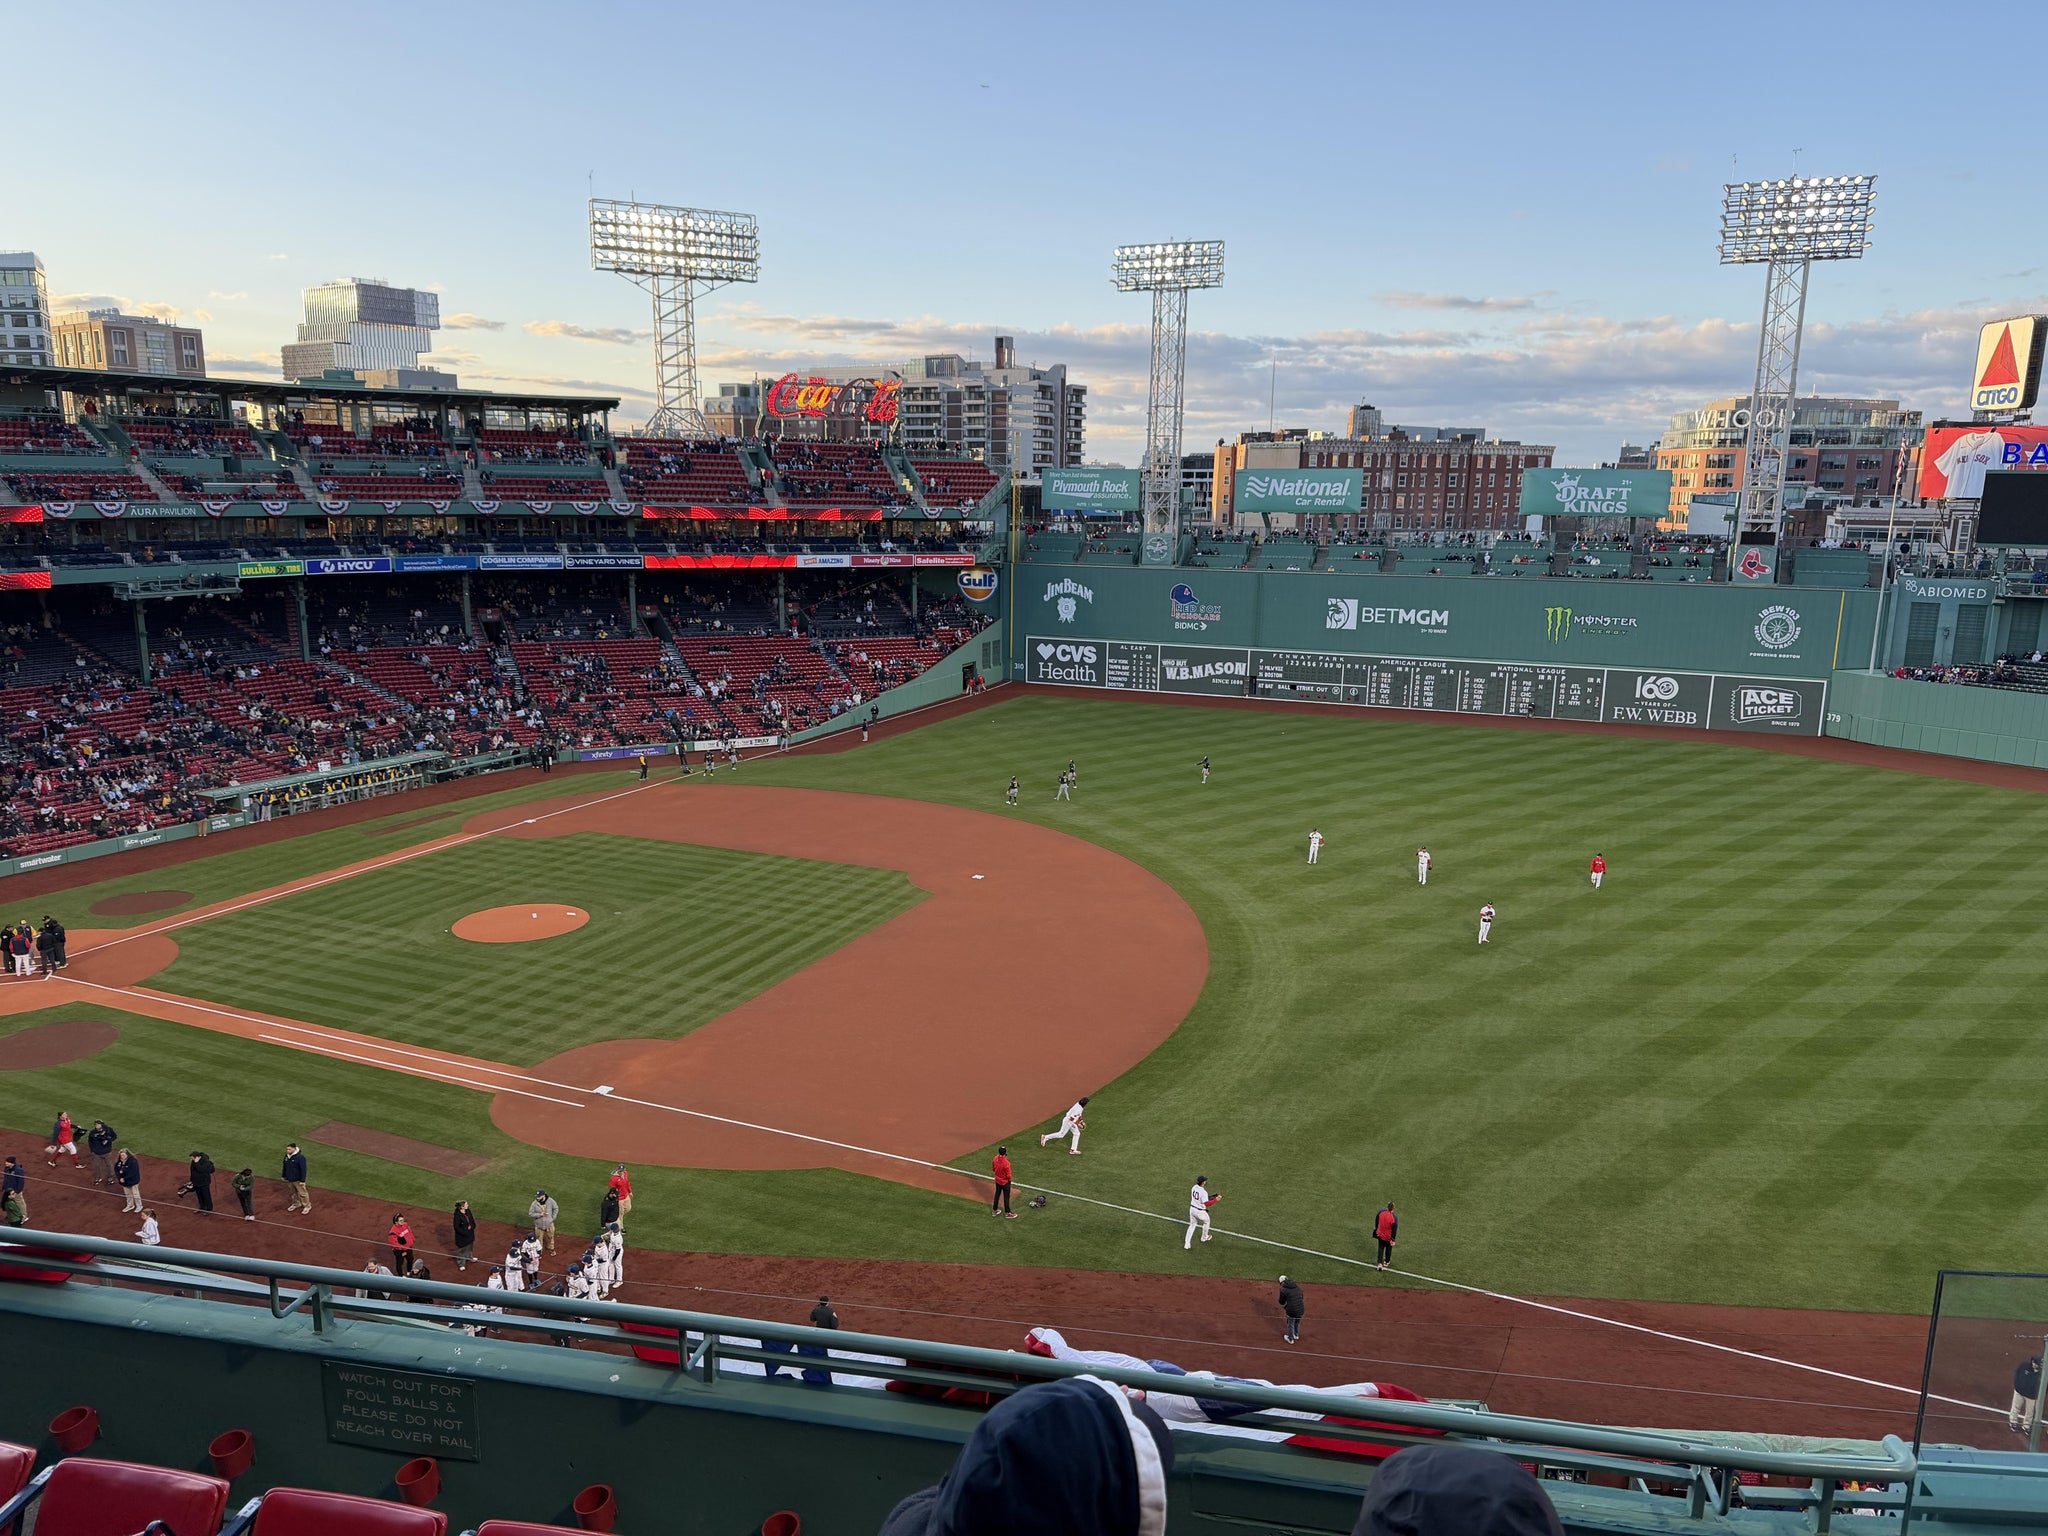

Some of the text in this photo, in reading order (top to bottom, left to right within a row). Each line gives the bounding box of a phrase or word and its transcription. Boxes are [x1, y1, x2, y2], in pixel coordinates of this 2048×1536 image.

[1977, 387, 2018, 406] CITGO
[1974, 454, 1990, 465] SOX
[1052, 480, 1129, 493] Plymouth Rock
[1556, 485, 1632, 502] DRAFT
[160, 508, 196, 516] PAVILION
[1564, 500, 1627, 513] KINGS
[241, 565, 301, 575] SULLIVAN TIRE
[338, 560, 373, 570] HYCU
[959, 573, 995, 588] Gulf
[1917, 587, 1987, 599] ABIOMED
[1175, 612, 1221, 621] SCHOLARS
[1362, 607, 1449, 626] BETMGM
[1758, 605, 1800, 620] IBEW 103
[1174, 622, 1199, 630] BIDMC
[1574, 614, 1638, 627] MONSTER
[1760, 627, 1801, 650] CONTRACTORS
[1056, 644, 1097, 663] CVS
[1038, 662, 1096, 682] Health
[1635, 675, 1679, 700] 160
[1745, 690, 1794, 706] ACE
[1613, 706, 1697, 724] F.W. WEBB
[1745, 706, 1794, 715] TICKET
[1827, 713, 1841, 722] 379
[591, 751, 613, 759] xfinity
[124, 834, 161, 847] ACE TICKET
[20, 854, 62, 869] smartwater
[338, 1371, 461, 1397] WATCH OUT FOR
[347, 1389, 456, 1413] FOUL BALLS &
[343, 1405, 463, 1431] PLEASE DO NOT
[336, 1420, 472, 1449] REACH OVER RAIL
